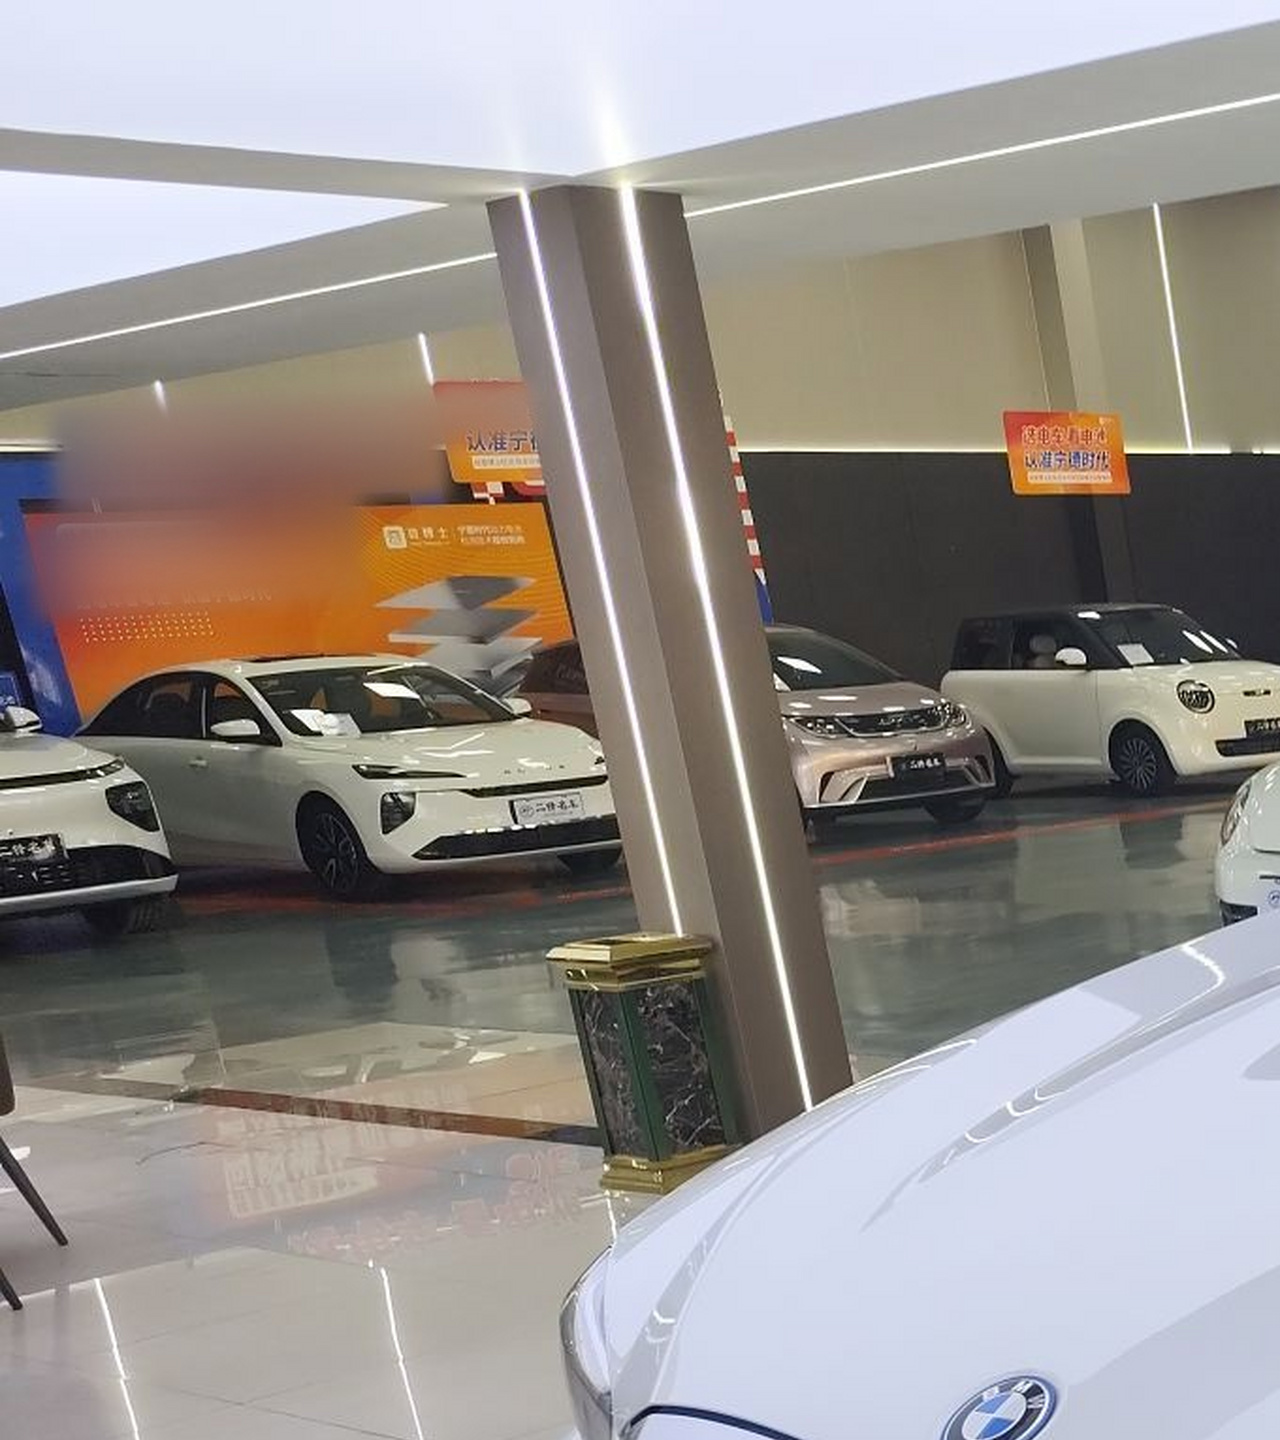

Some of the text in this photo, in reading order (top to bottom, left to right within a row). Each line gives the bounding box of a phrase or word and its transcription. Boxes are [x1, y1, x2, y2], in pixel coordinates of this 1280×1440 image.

[1025, 451, 1110, 469] 认准宁德时代
